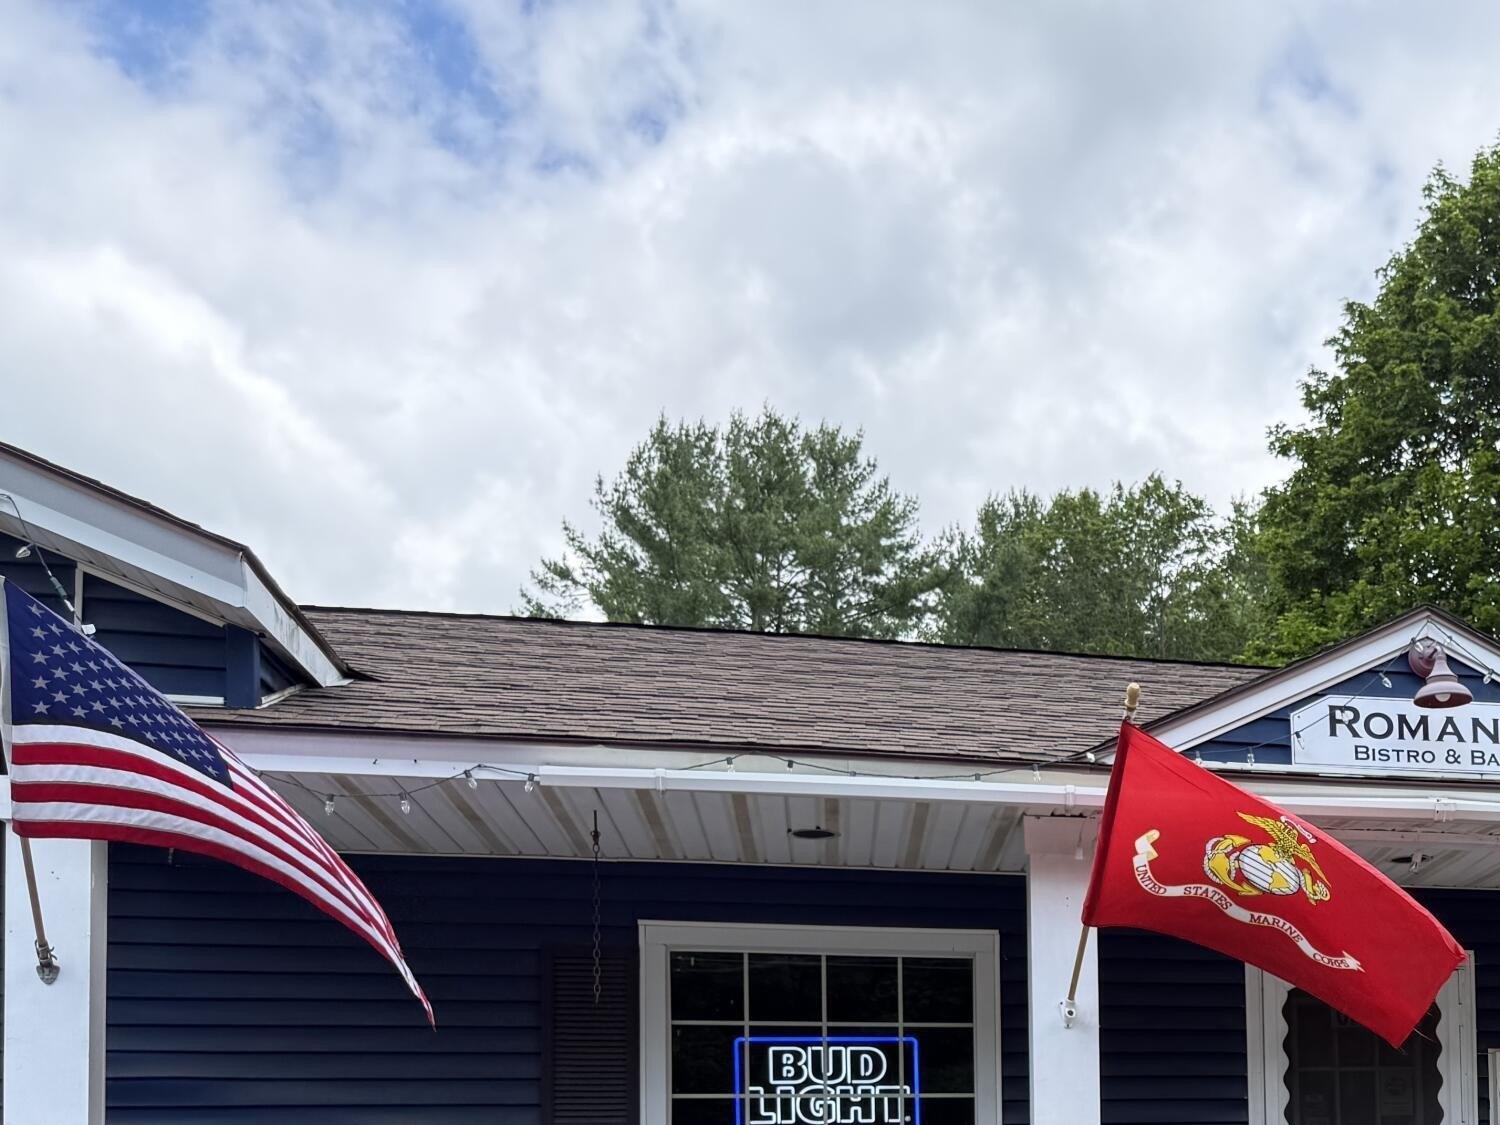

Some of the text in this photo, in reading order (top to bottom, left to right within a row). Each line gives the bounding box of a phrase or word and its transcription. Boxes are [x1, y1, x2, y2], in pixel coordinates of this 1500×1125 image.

[1354, 745, 1436, 764] BISTRO
[1445, 749, 1462, 765] &
[1135, 864, 1350, 969] UNITED STATES MARINE CORPS
[768, 1046, 887, 1085] BUD
